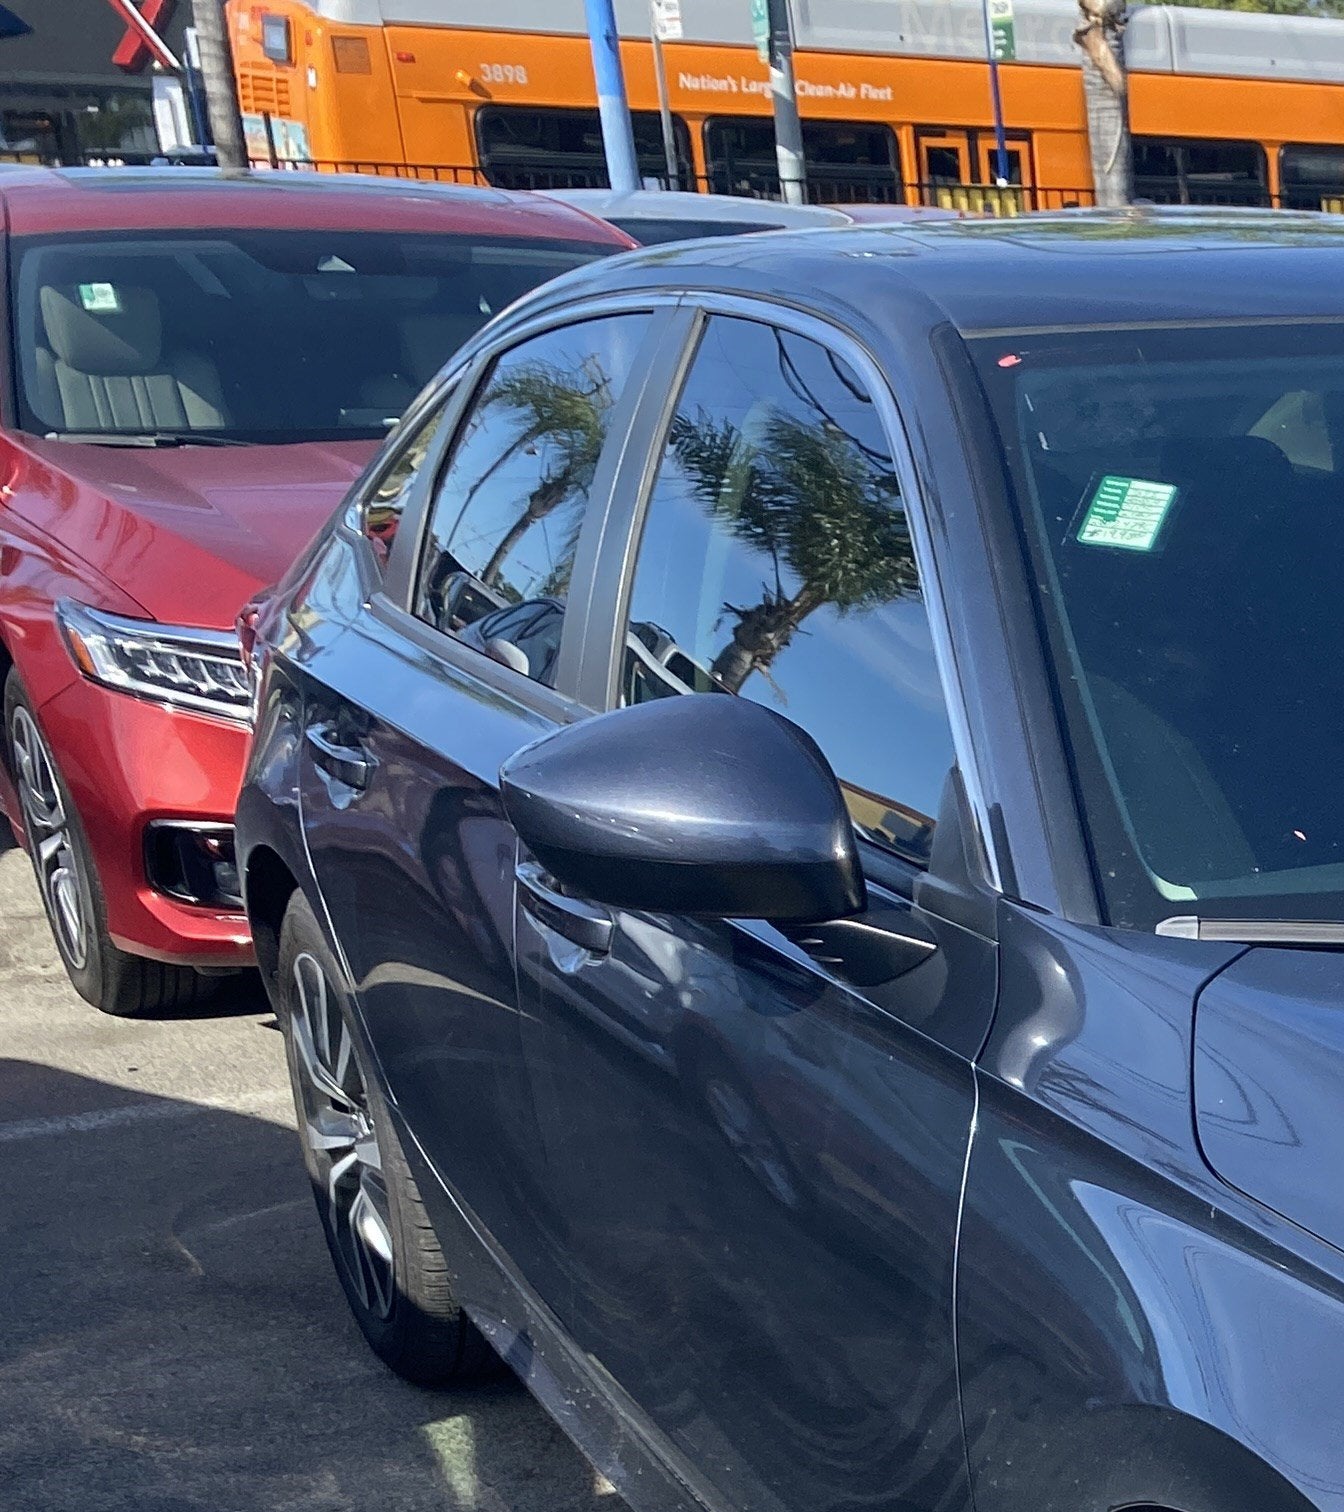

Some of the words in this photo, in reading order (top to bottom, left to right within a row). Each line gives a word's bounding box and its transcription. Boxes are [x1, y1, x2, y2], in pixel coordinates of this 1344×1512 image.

[480, 63, 528, 85] 3898
[678, 72, 738, 93] Nation's
[741, 76, 776, 99] Larg
[795, 79, 856, 99] Clean-Air
[860, 84, 892, 100] Fleet
